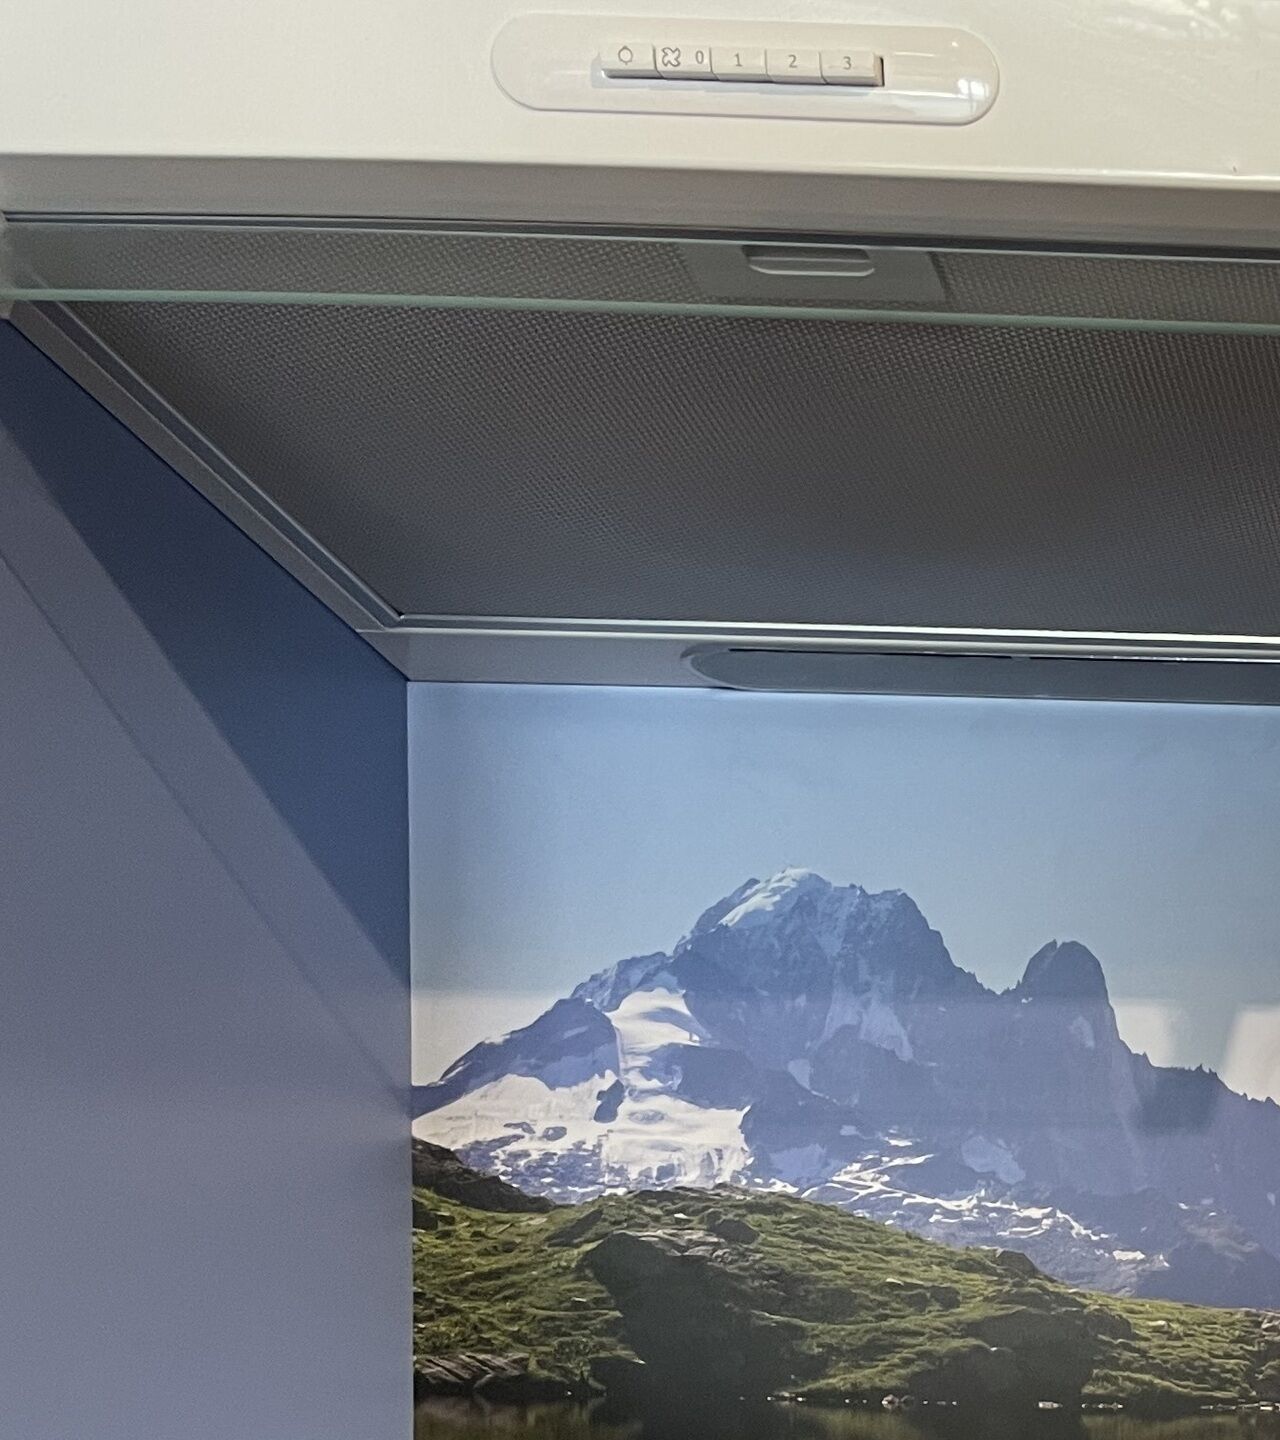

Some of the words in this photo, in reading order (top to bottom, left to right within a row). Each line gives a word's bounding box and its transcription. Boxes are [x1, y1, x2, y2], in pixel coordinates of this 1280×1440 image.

[695, 49, 705, 65] 0
[734, 54, 743, 68] 1
[788, 54, 798, 69] 2
[843, 56, 852, 70] 3
